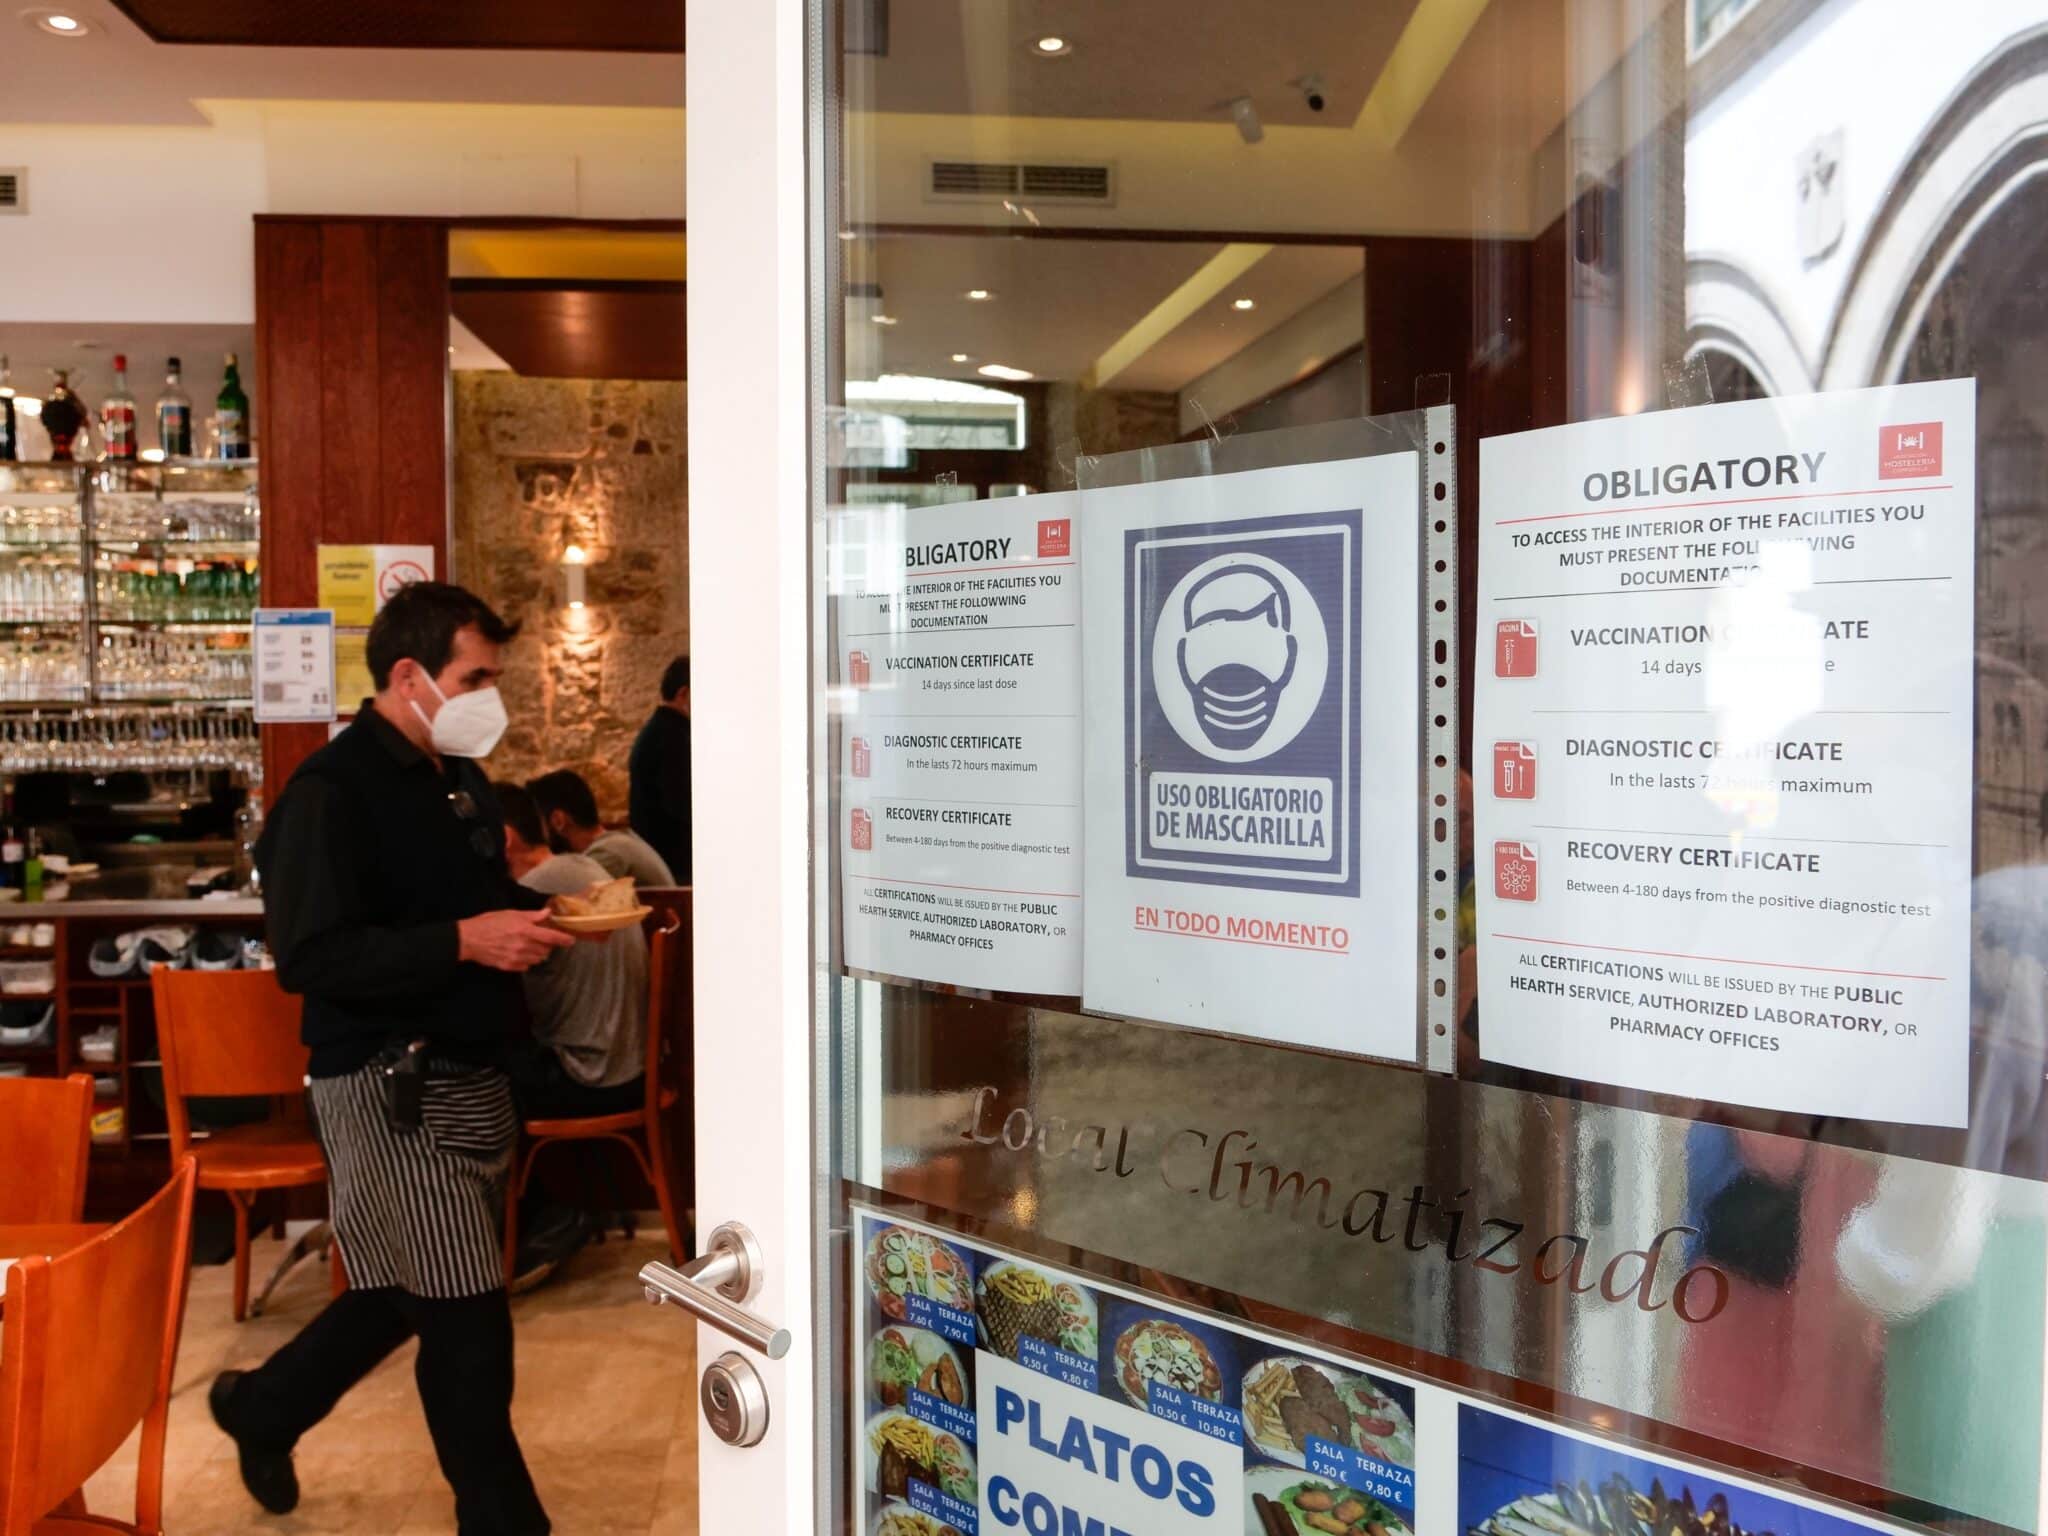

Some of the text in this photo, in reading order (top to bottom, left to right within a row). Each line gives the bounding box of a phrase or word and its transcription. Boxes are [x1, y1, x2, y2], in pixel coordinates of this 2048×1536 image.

[1582, 452, 1827, 502] OBLIGATORY
[1512, 504, 1924, 548] TO ACCESS THE INTERIOR OF THE FACILITIES YOU
[904, 537, 1012, 567] BLIGATORY
[1560, 551, 1604, 567] MUST
[1608, 545, 1679, 564] PRESENT
[1684, 543, 1717, 558] THE
[913, 582, 952, 596] INTERIOR
[954, 580, 966, 592] OF
[968, 579, 985, 591] THE
[987, 576, 1036, 590] FACILITIES
[1039, 575, 1061, 586] YOU
[942, 598, 958, 610] THE
[960, 594, 1026, 608] FOLLOWWING
[911, 614, 988, 628] DOCUMENTATION
[1571, 626, 1713, 646] VACCINATION
[886, 653, 1034, 670] VACCINATION CERTIFICATE
[1641, 660, 1660, 674] 14
[1666, 659, 1702, 677] days
[922, 678, 1018, 692] 14 days since last dose
[884, 735, 1022, 750] DIAGNOSTIC CERTIFICATE
[1566, 740, 1693, 758] DIAGNOSTIC
[907, 759, 1038, 772] In the lasts 72 hours maximum
[1157, 784, 1323, 814] USO OBLIGATORIO
[1610, 772, 1624, 786] In
[1628, 772, 1654, 788] the
[1659, 773, 1695, 788] lasts
[1782, 778, 1872, 794] maximum
[886, 807, 1012, 826] RECOVERY CERTIFICATE
[1156, 811, 1325, 848] DE MASCARILLA
[886, 834, 1070, 855] Between 4-180 days from the positive diagnostic test
[1567, 841, 1820, 873] RECOVERY CERTIFICATE
[864, 888, 1058, 916] ALL CERTIFICATIONS WILL BE ISSUED BY THE PUBLIC
[1566, 878, 1931, 917] Between 4-180 days from the positive diagnostic test
[859, 904, 1066, 936] HEARTH SERVICE, AUTHORIZED LABORATORY, OR
[1135, 906, 1348, 949] EN TODO MOMENTO
[910, 930, 994, 950] PHARMACY OFFICES
[1519, 953, 1904, 1006] ALL CERTIFICATIONS WILL BE ISSUED BY THE PUBLIC
[1510, 976, 1918, 1036] HEARTH SERVICE, AUTHORIZED LABORATORY, OR
[1610, 1016, 1780, 1052] PHARMACY OFFICES
[960, 1086, 1730, 1323] Local Climatizado
[912, 1298, 974, 1328] SALA TERRAZA
[1023, 1356, 1040, 1370] 9,50
[1043, 1364, 1048, 1374] €
[1083, 1379, 1089, 1389] €
[1024, 1340, 1096, 1375] SALA TERRAZA
[913, 1392, 975, 1425] SALA TERRAZA
[1152, 1404, 1178, 1421] 10,50
[1181, 1415, 1187, 1424] €
[1229, 1432, 1236, 1442] €
[1156, 1388, 1240, 1426] SALA TERRAZA
[995, 1386, 1216, 1518] PLATOS
[1314, 1442, 1412, 1487] SALA TERRAZA
[1312, 1460, 1402, 1502] 9,50 € 9,80 €
[914, 1484, 976, 1518] SALA TERRAZA
